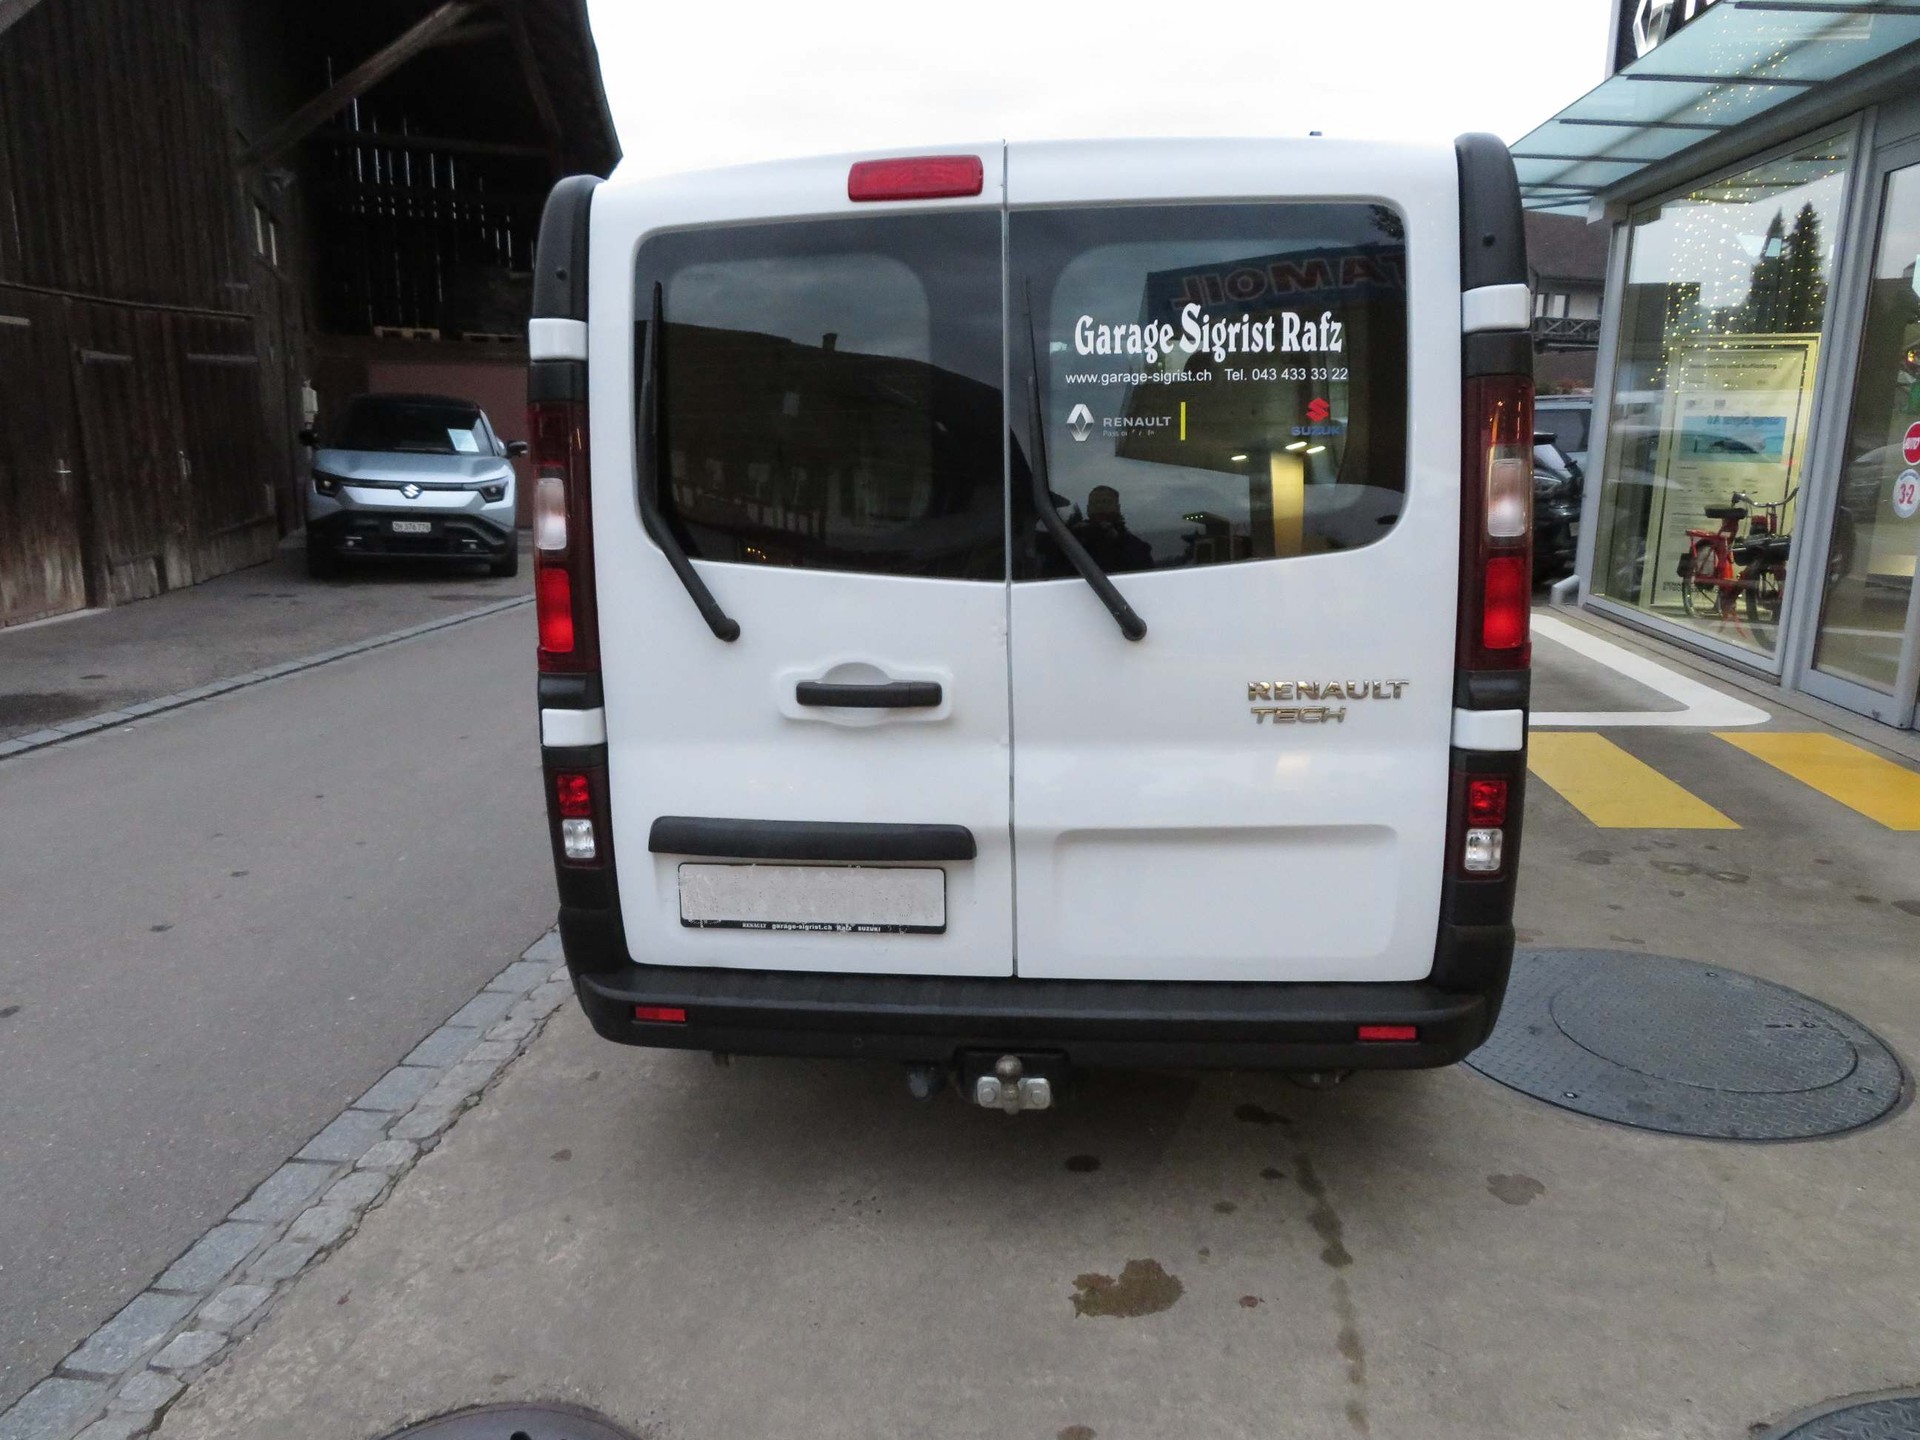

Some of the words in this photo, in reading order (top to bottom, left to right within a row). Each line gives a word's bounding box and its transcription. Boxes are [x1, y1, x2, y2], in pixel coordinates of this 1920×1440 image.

[1074, 314, 1174, 363] Garage
[1179, 302, 1275, 362] Sigrist
[1281, 311, 1343, 353] Rafz
[1065, 369, 1212, 385] www.garage-sigrist.ch
[1225, 368, 1247, 381] Tel.
[1252, 368, 1277, 381] 043
[1281, 368, 1306, 380] 433
[1311, 368, 1327, 380] 33
[1332, 367, 1348, 380] 22
[1102, 416, 1172, 428] RENAULT
[1247, 679, 1410, 701] RENAULT
[1251, 705, 1347, 724] TECH
[771, 922, 833, 931] garage-sigrist.ch
